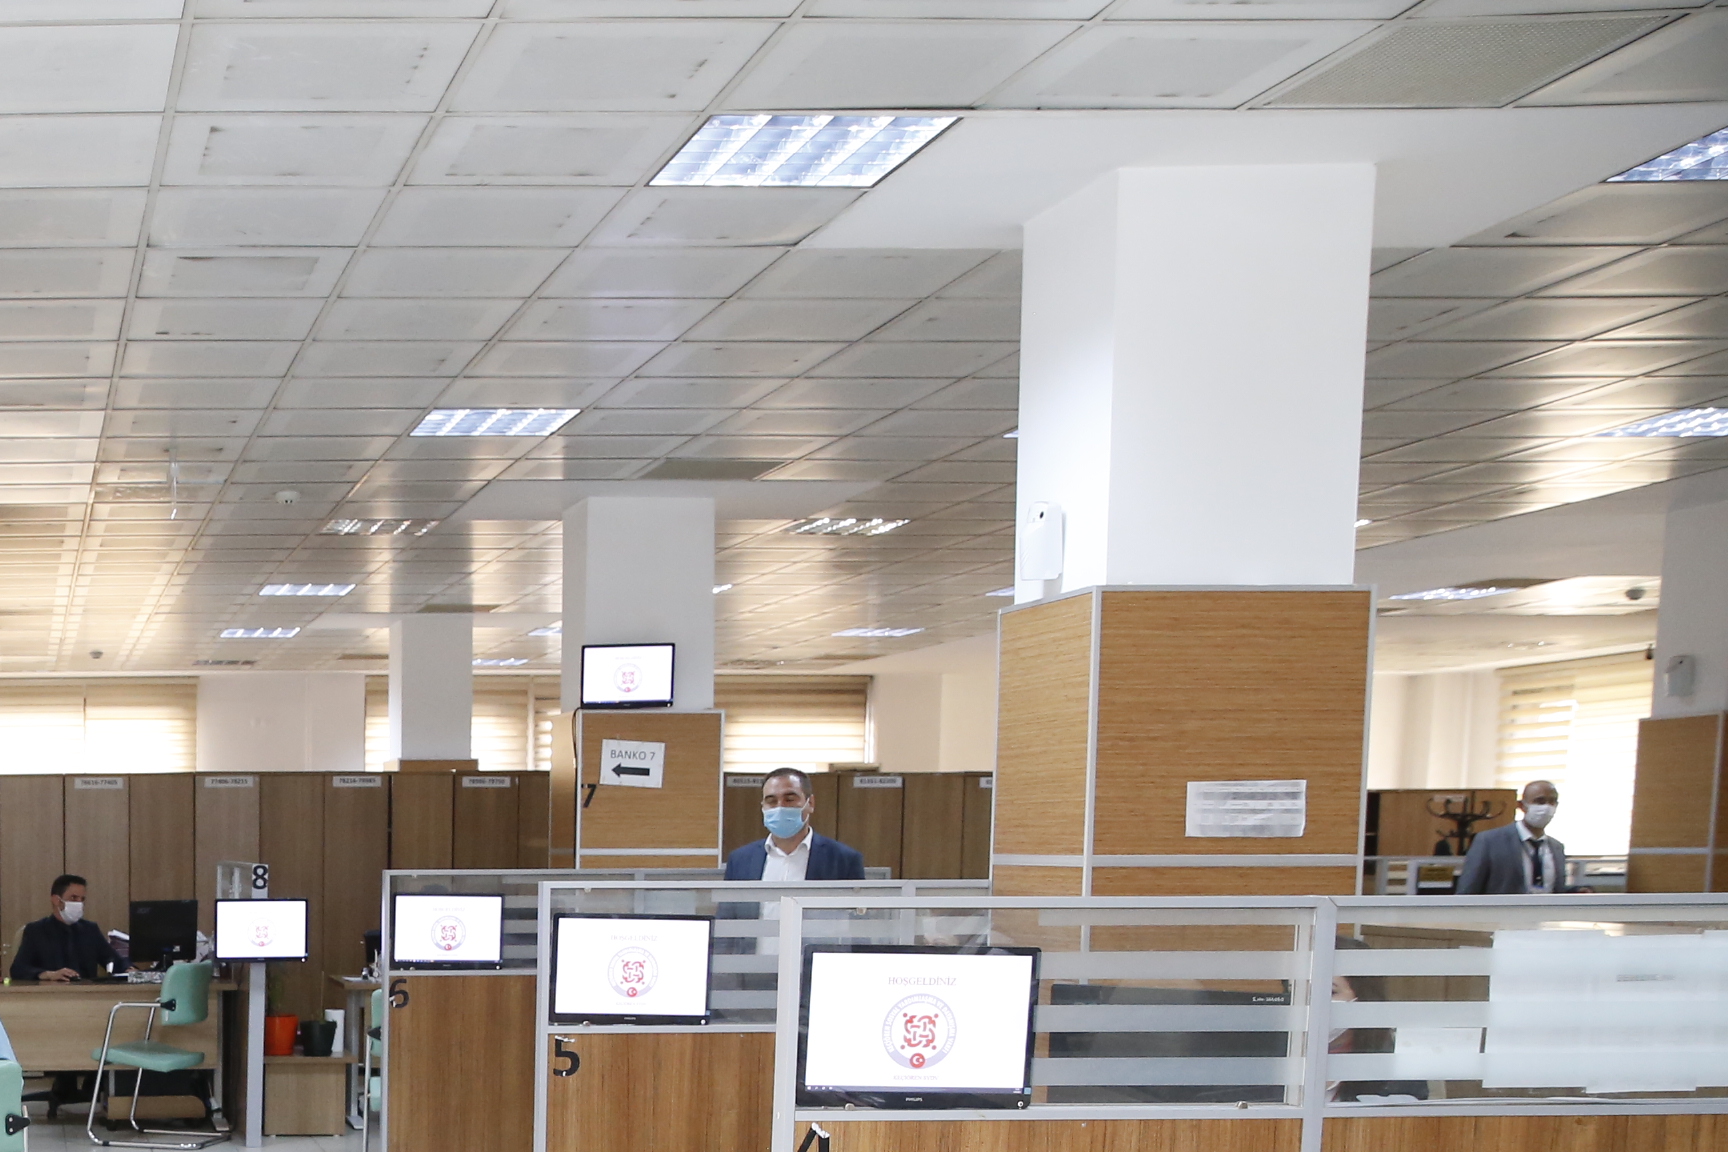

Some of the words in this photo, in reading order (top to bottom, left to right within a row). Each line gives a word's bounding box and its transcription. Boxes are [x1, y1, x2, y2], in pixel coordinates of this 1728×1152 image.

[610, 749, 647, 761] BANKO
[649, 751, 656, 761] 7
[581, 783, 597, 808] 7
[252, 865, 268, 890] 8
[389, 978, 410, 1009] 6
[887, 975, 958, 987] HOŞGELDİNİZ
[553, 1035, 580, 1077] 5
